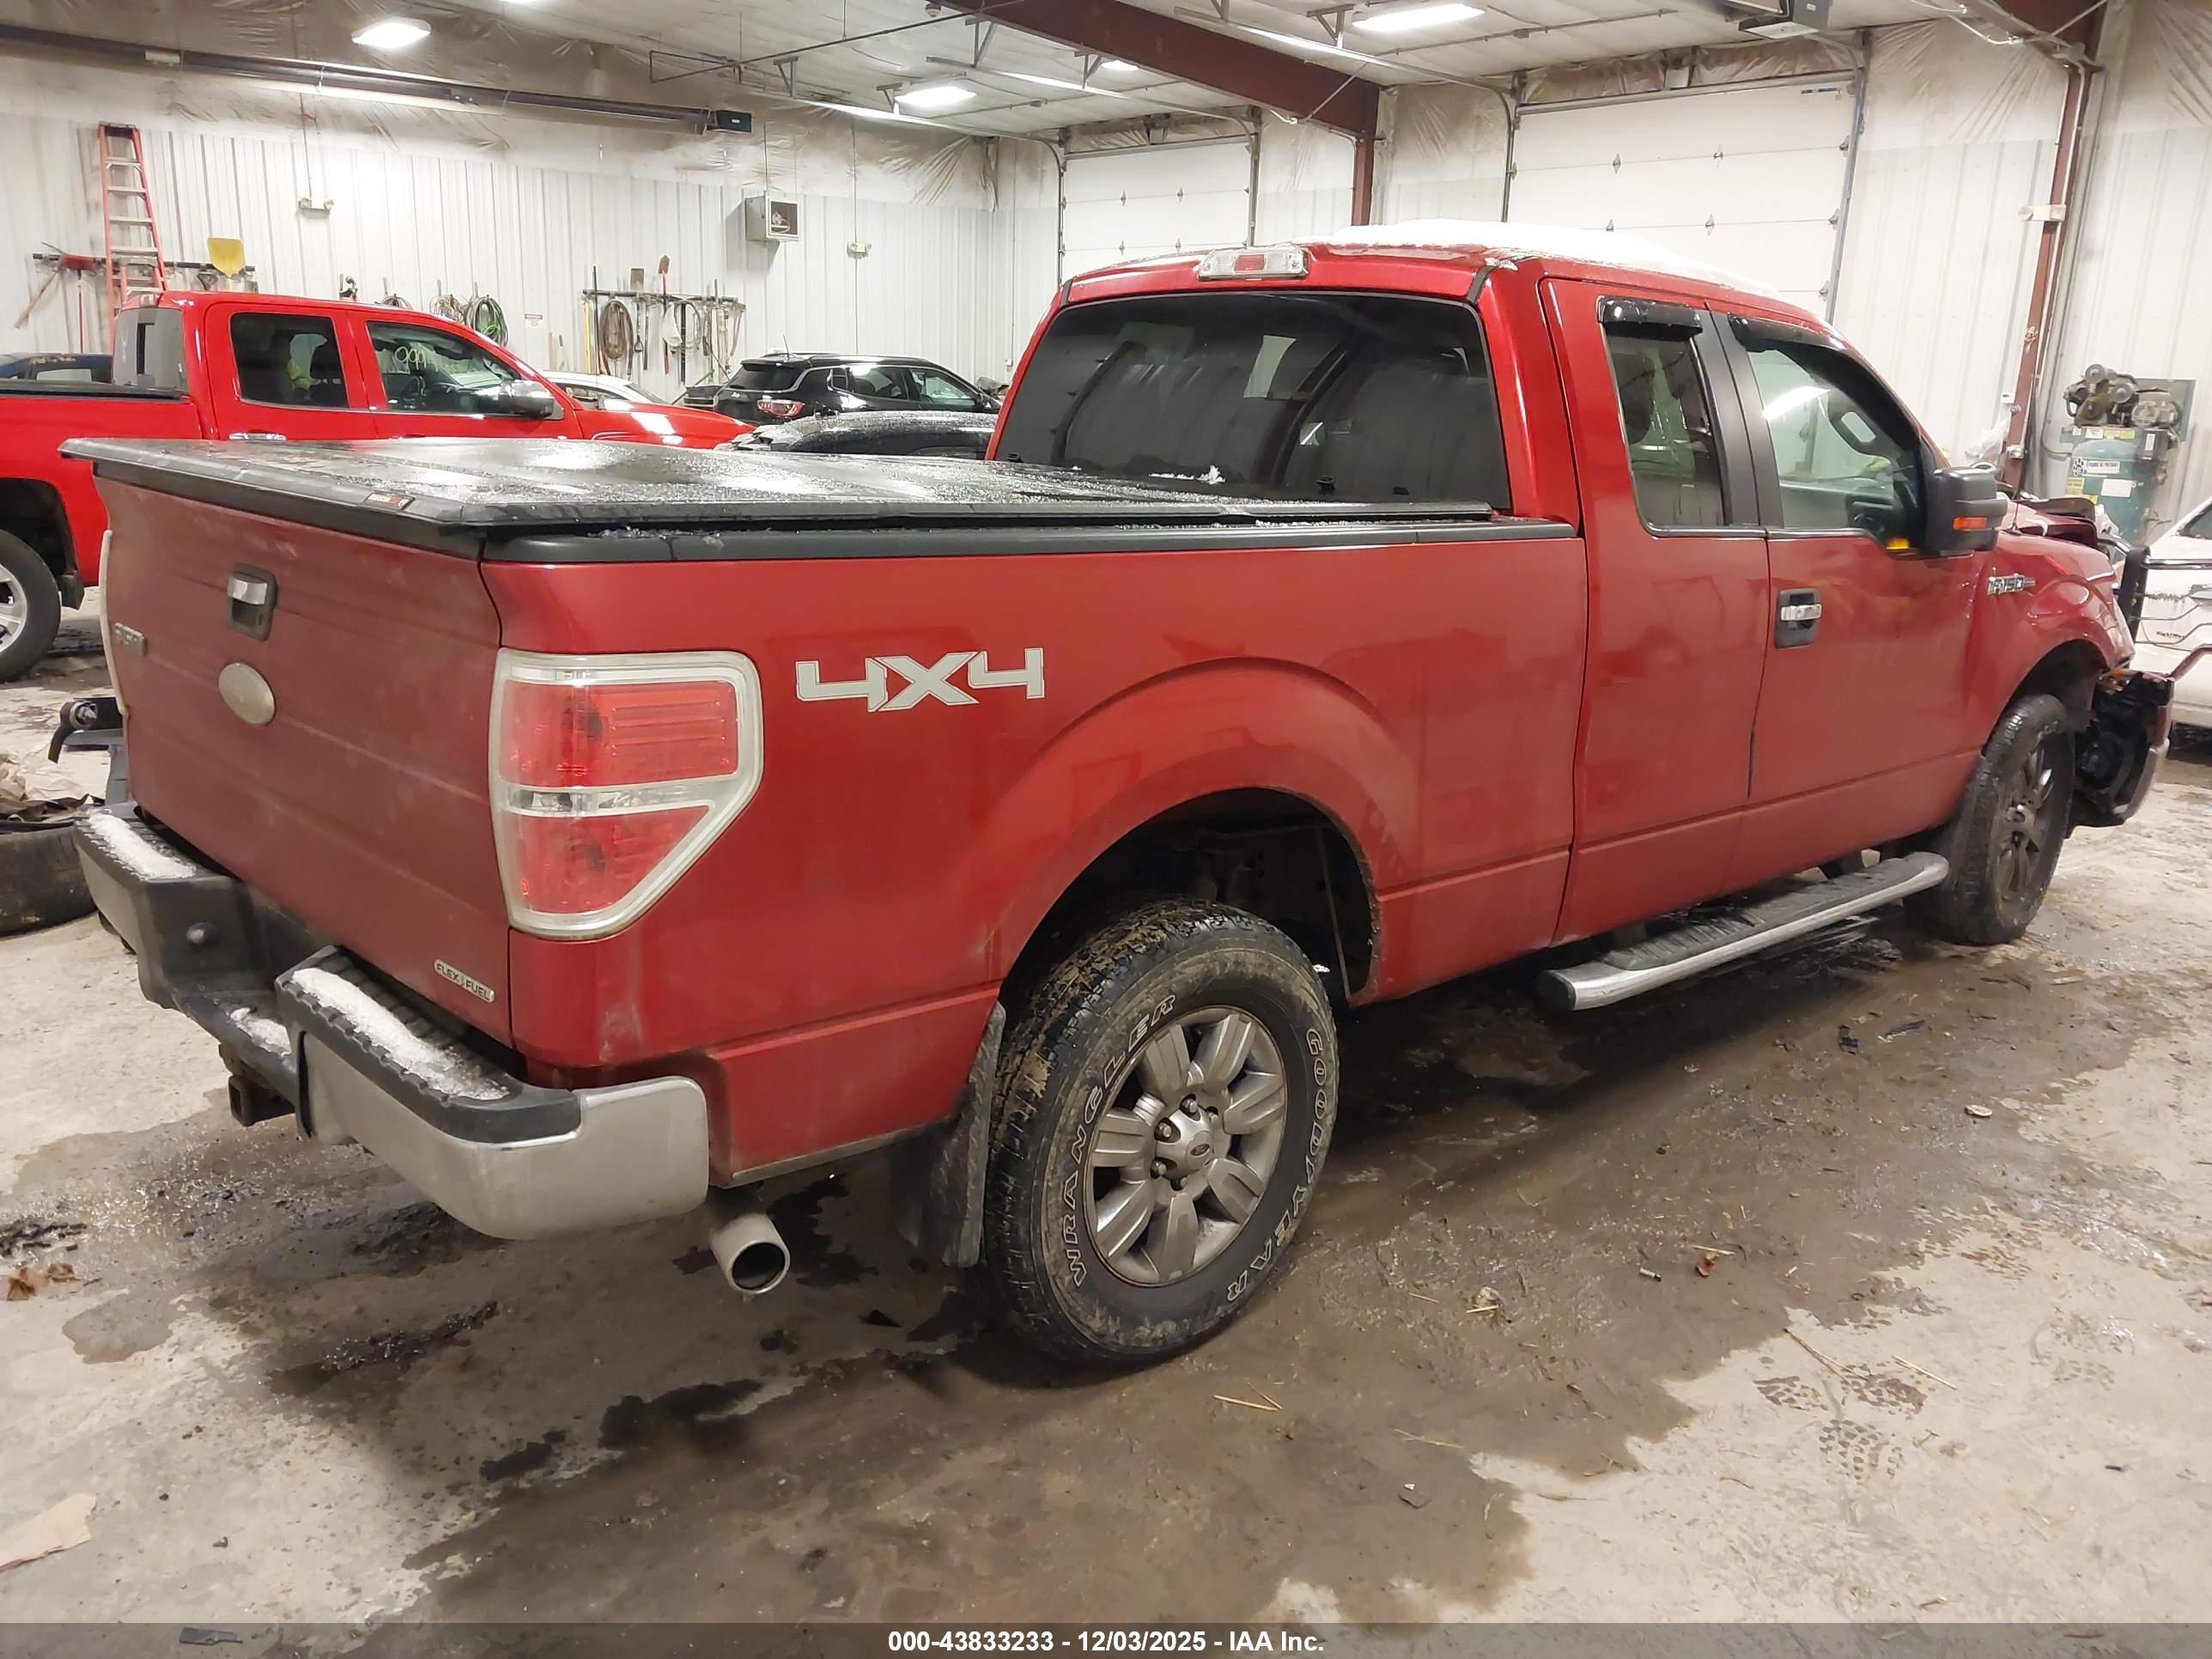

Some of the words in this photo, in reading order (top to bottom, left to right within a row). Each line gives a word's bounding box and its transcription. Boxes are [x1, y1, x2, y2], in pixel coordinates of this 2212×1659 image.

[795, 647, 1045, 713] 4X4
[436, 963, 459, 983] FLEX
[465, 979, 490, 1001] FUEL
[1063, 994, 1176, 1287] WRANGLER
[1226, 1029, 1328, 1302] GOODYEAR
